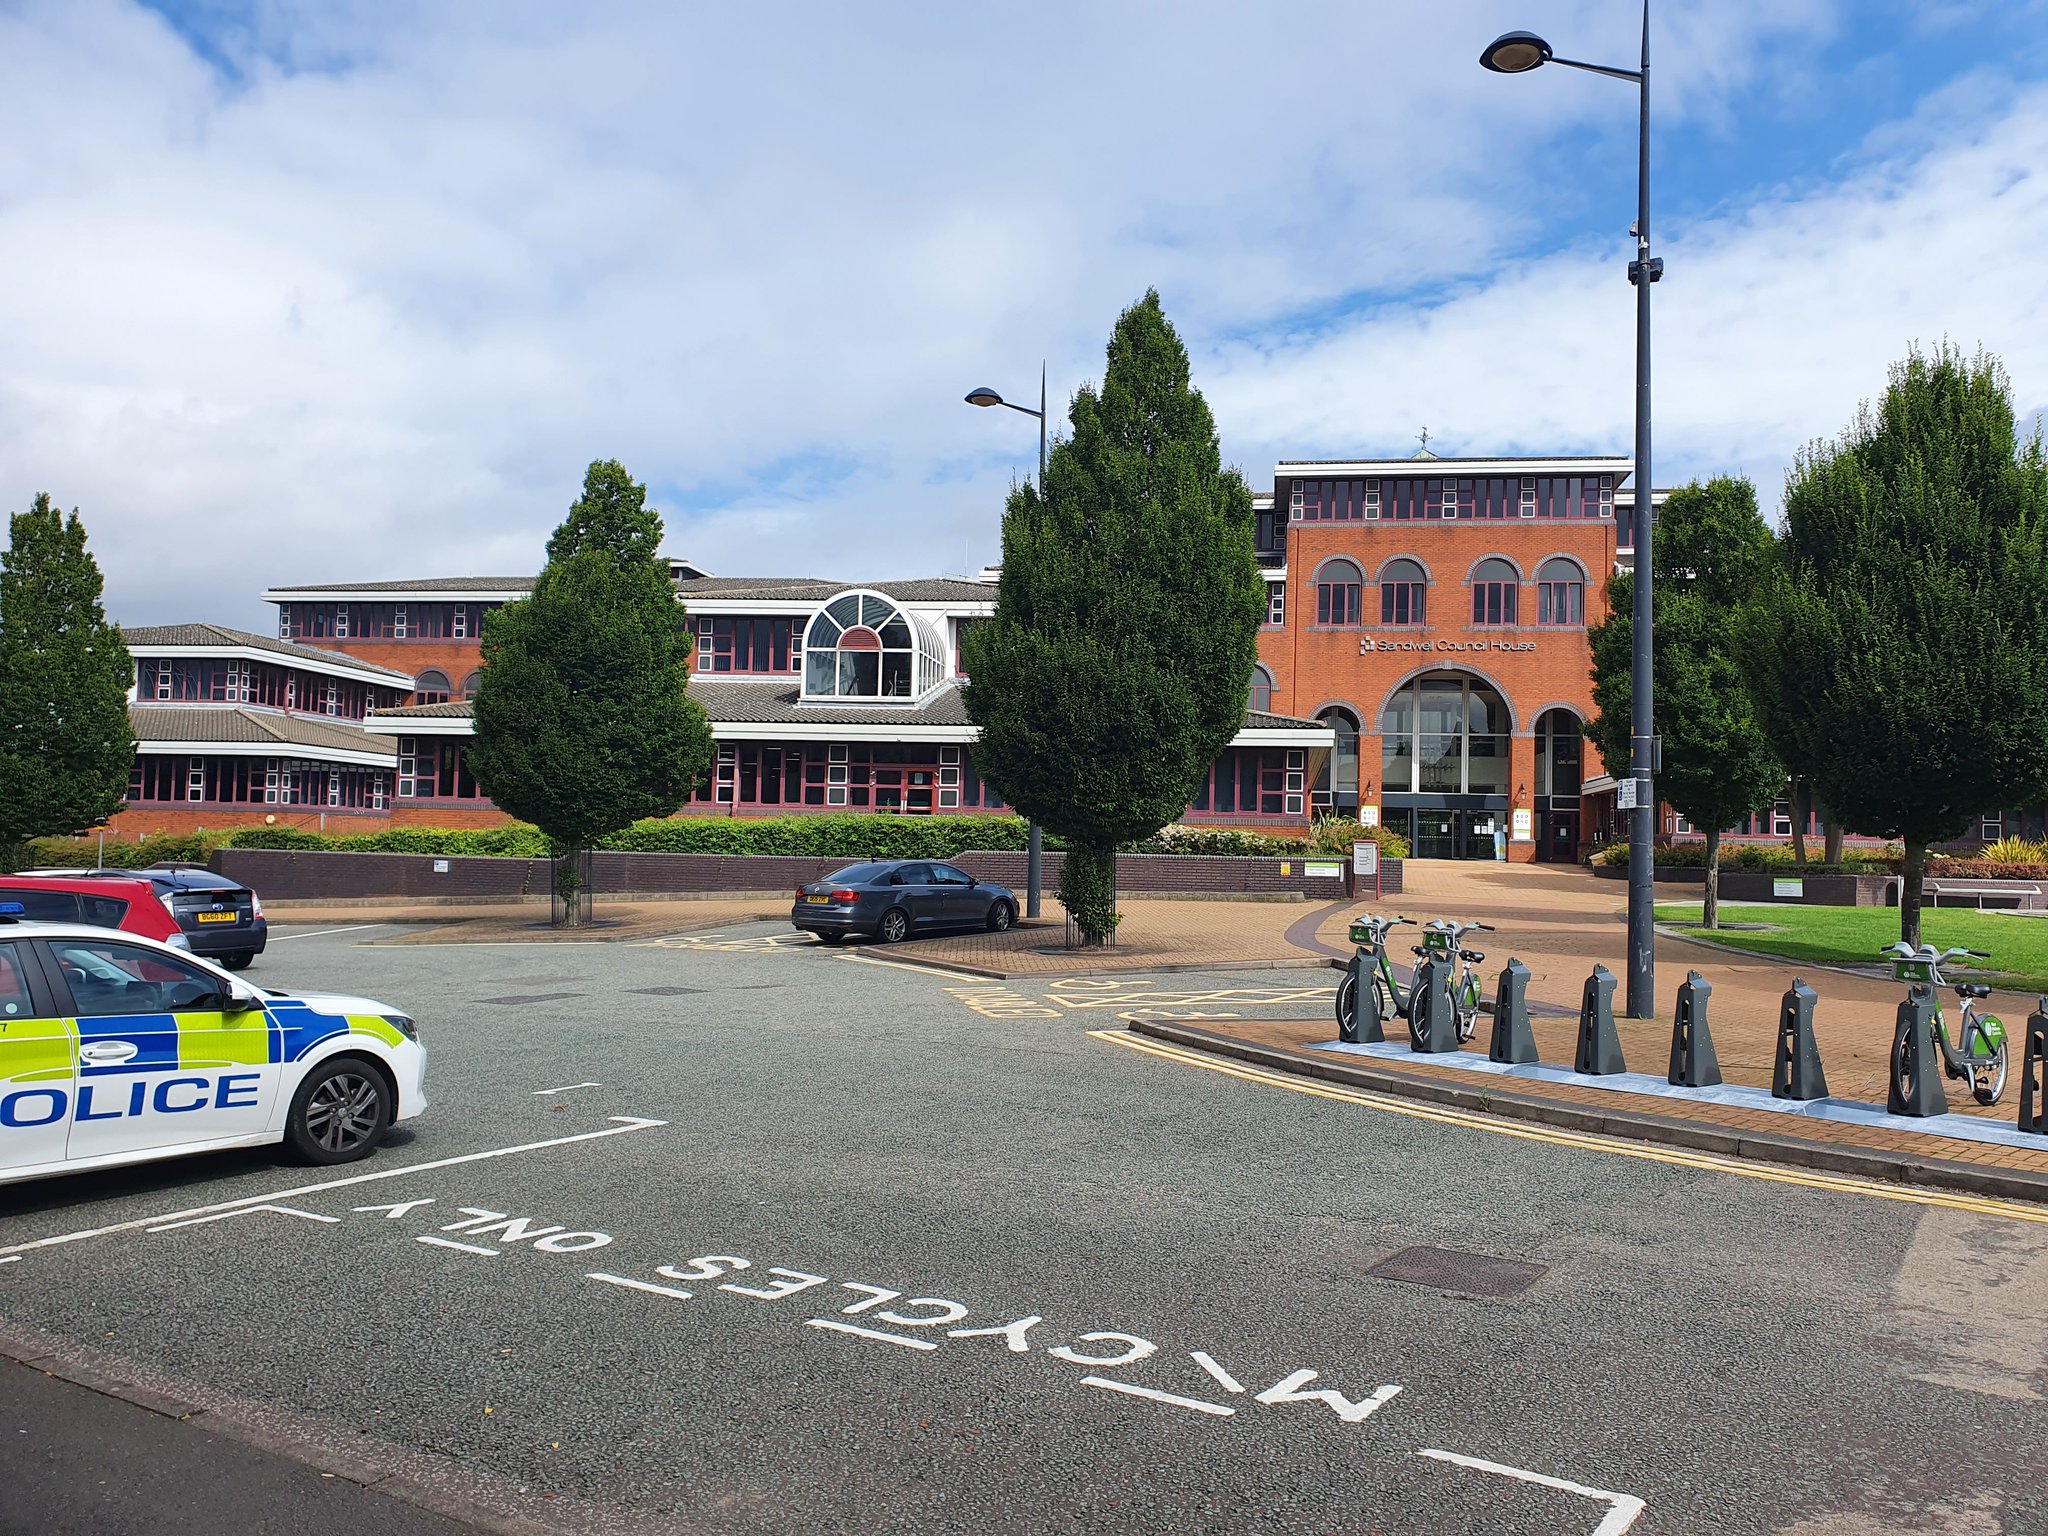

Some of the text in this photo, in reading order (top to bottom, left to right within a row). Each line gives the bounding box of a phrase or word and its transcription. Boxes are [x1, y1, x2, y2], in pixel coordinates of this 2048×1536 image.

[1377, 639, 1537, 652] Sandwell Council House
[350, 1198, 613, 1253] ONLY
